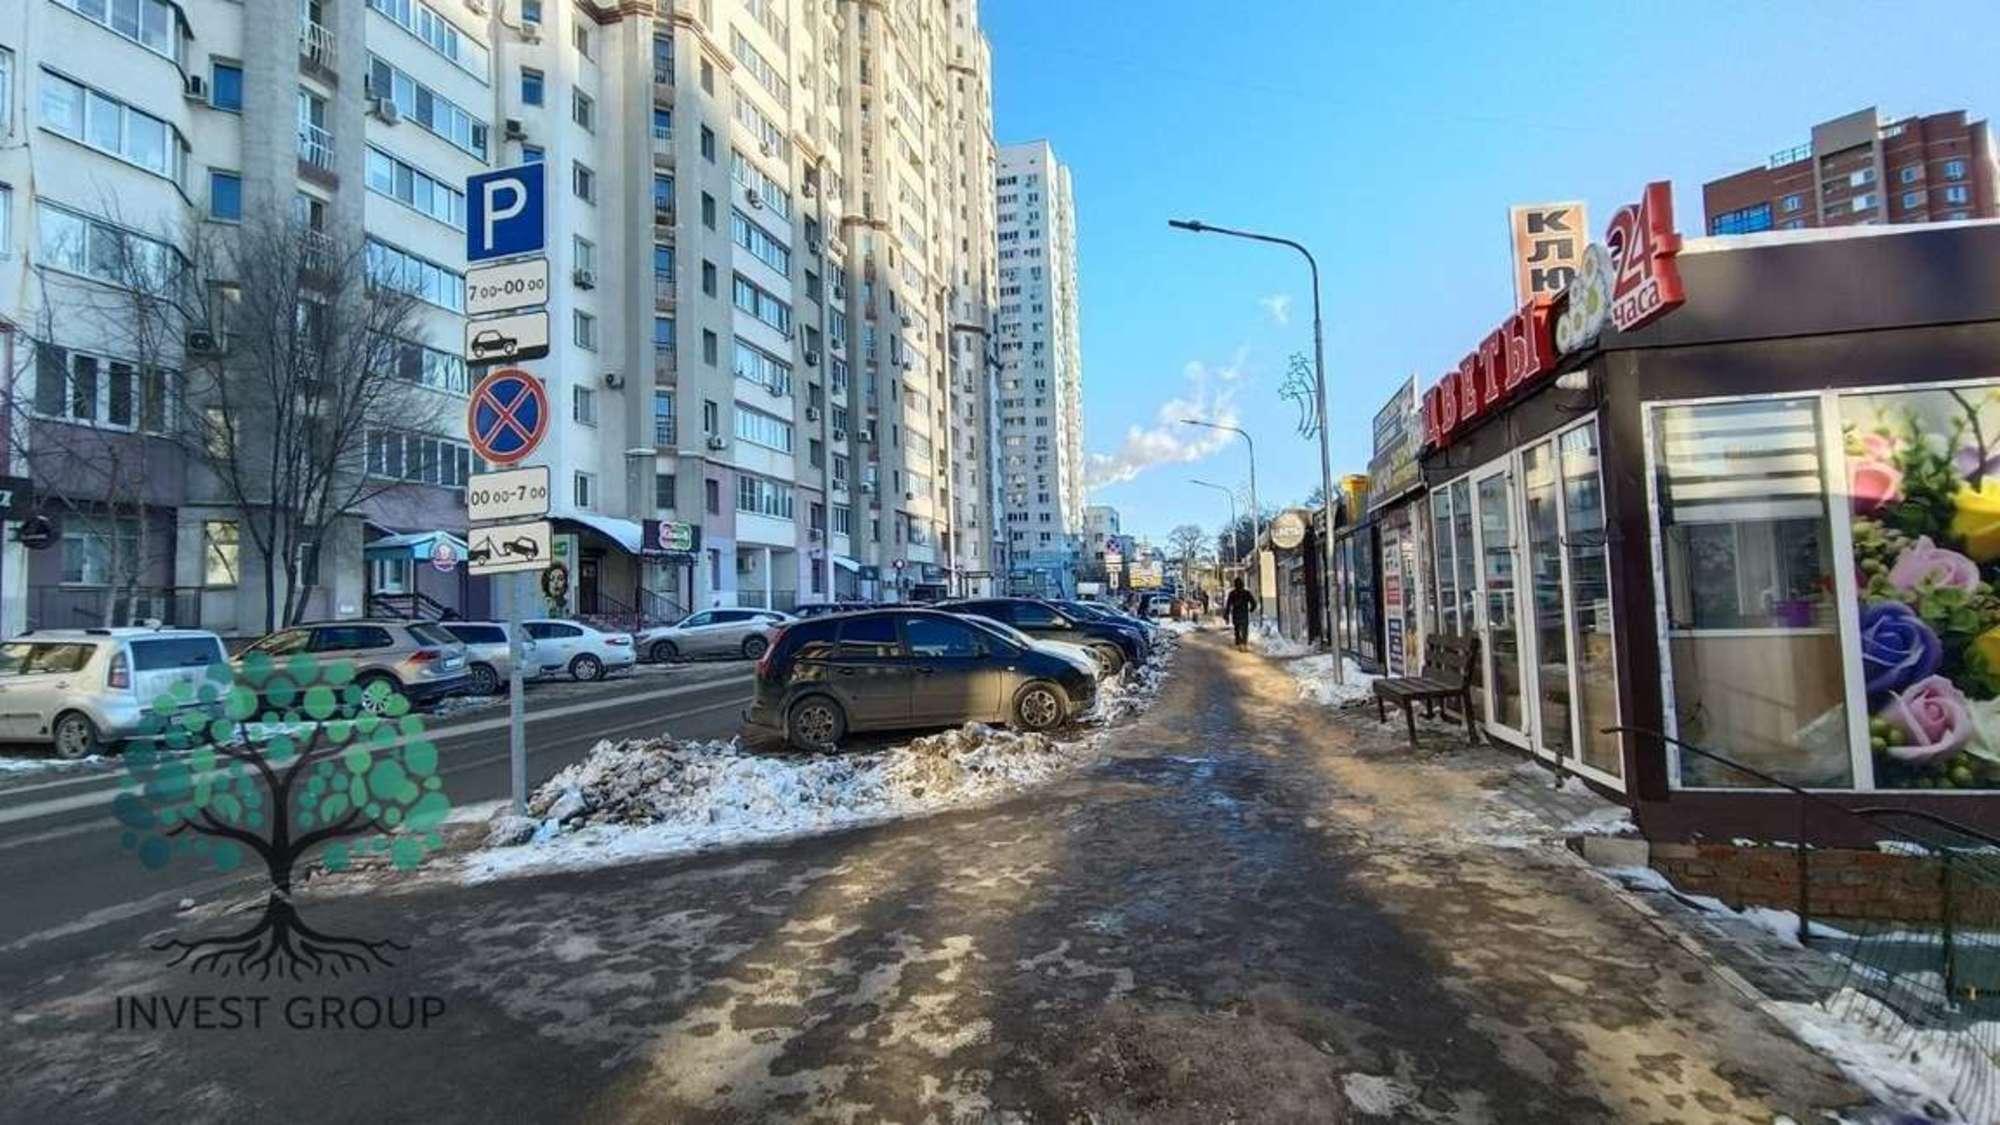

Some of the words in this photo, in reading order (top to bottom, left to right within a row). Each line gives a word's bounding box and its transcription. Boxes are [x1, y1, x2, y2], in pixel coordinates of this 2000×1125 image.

[483, 178, 527, 251] P
[1606, 181, 1662, 301] 24
[1612, 280, 1661, 327] часа
[1421, 302, 1543, 448] ЦВЕТЫ
